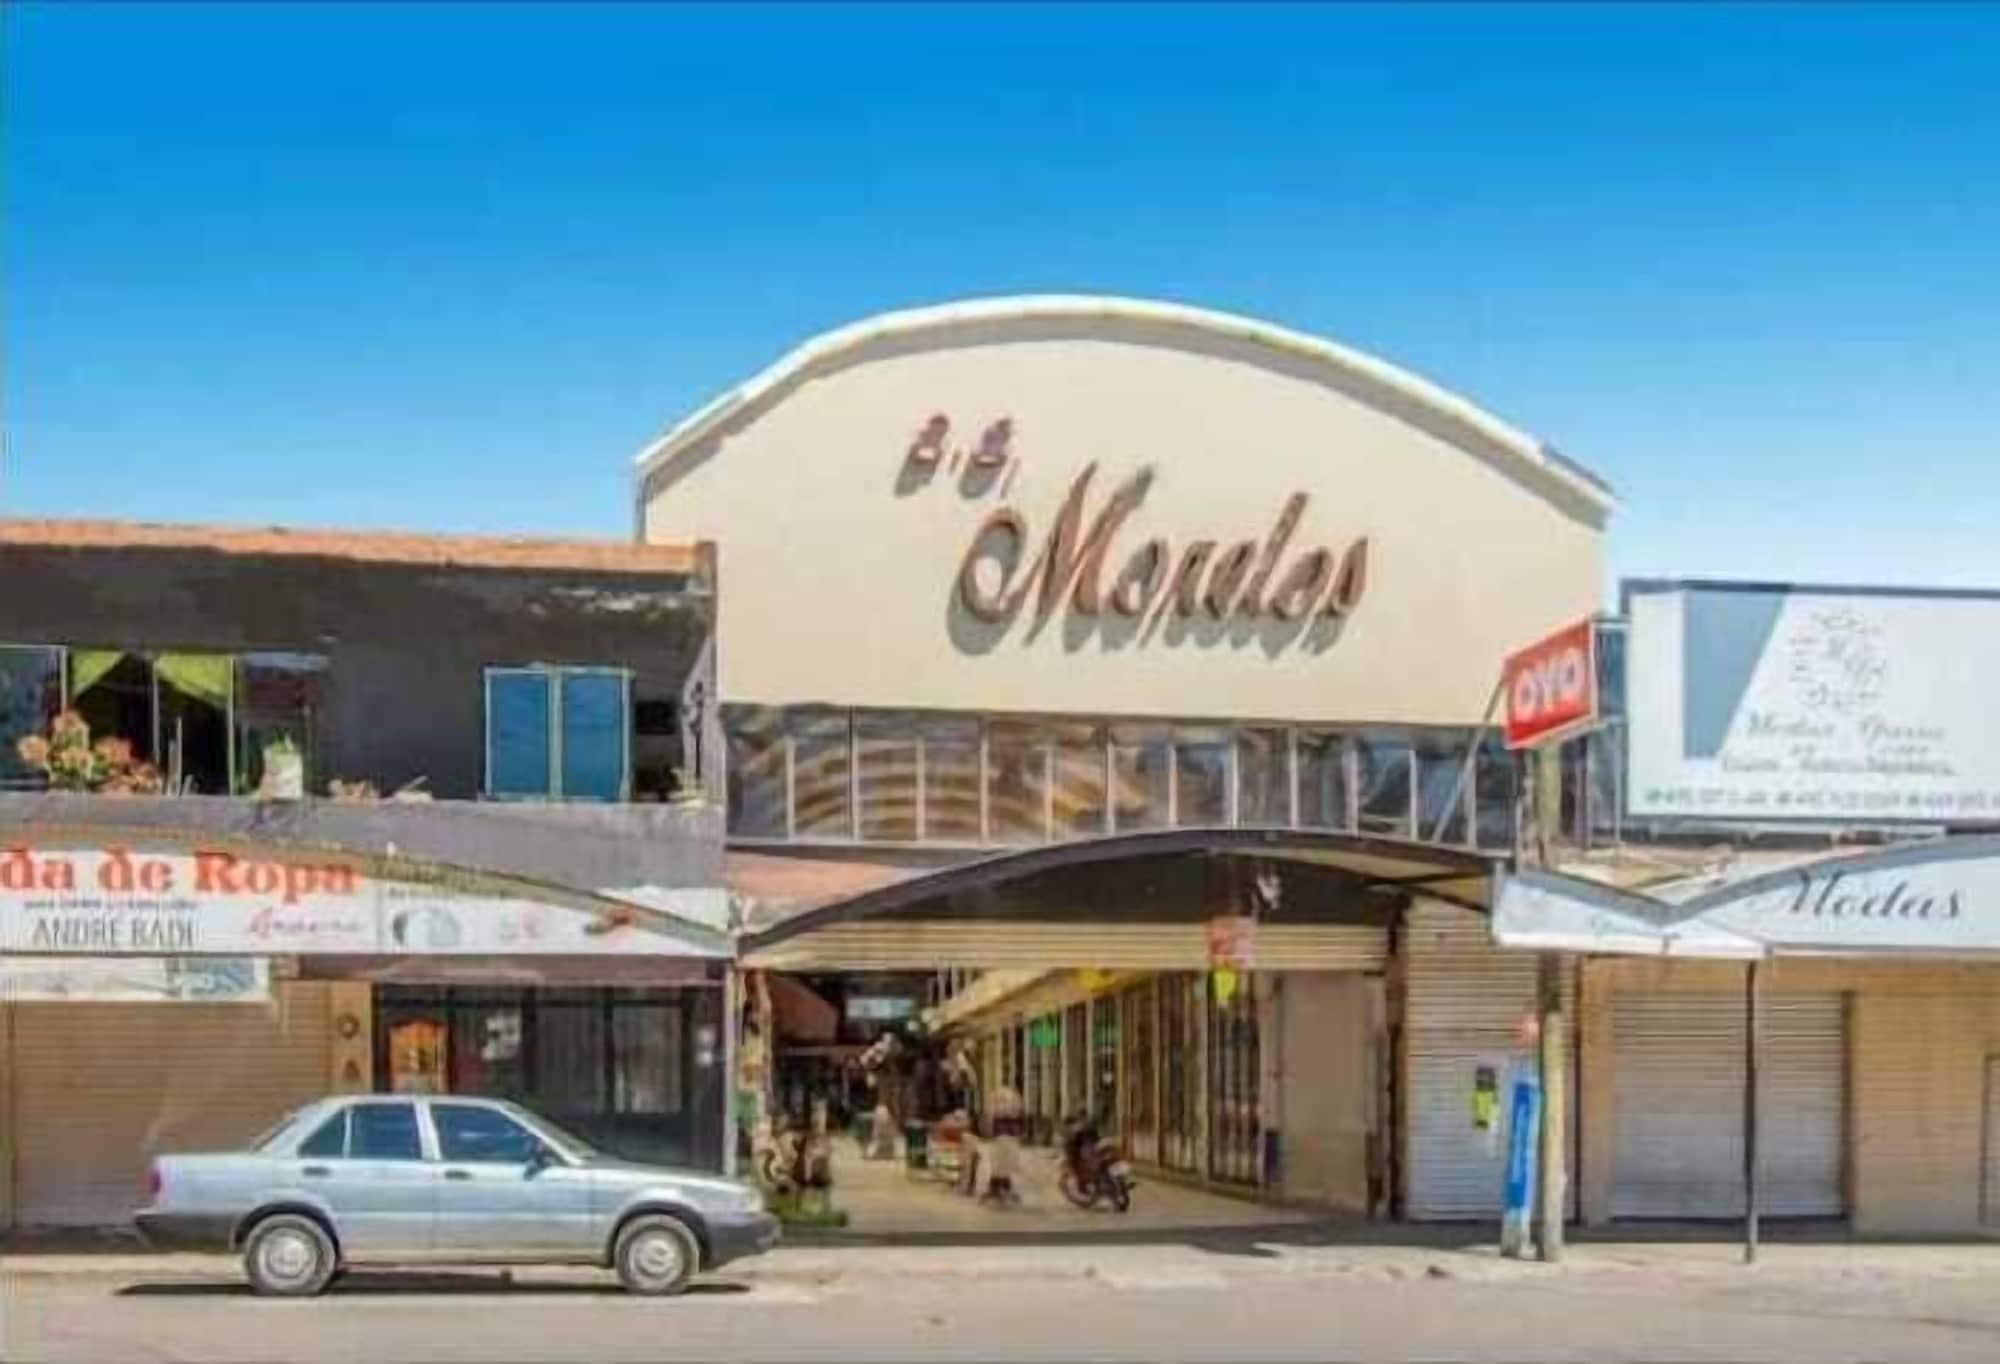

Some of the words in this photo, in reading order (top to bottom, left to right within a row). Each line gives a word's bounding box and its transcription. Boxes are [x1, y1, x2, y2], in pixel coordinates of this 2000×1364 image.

[952, 460, 1368, 635] Morelos
[1513, 650, 1584, 718] OYO
[98, 847, 173, 892] de
[194, 850, 362, 904] Ropa
[1790, 868, 1959, 917] Modas
